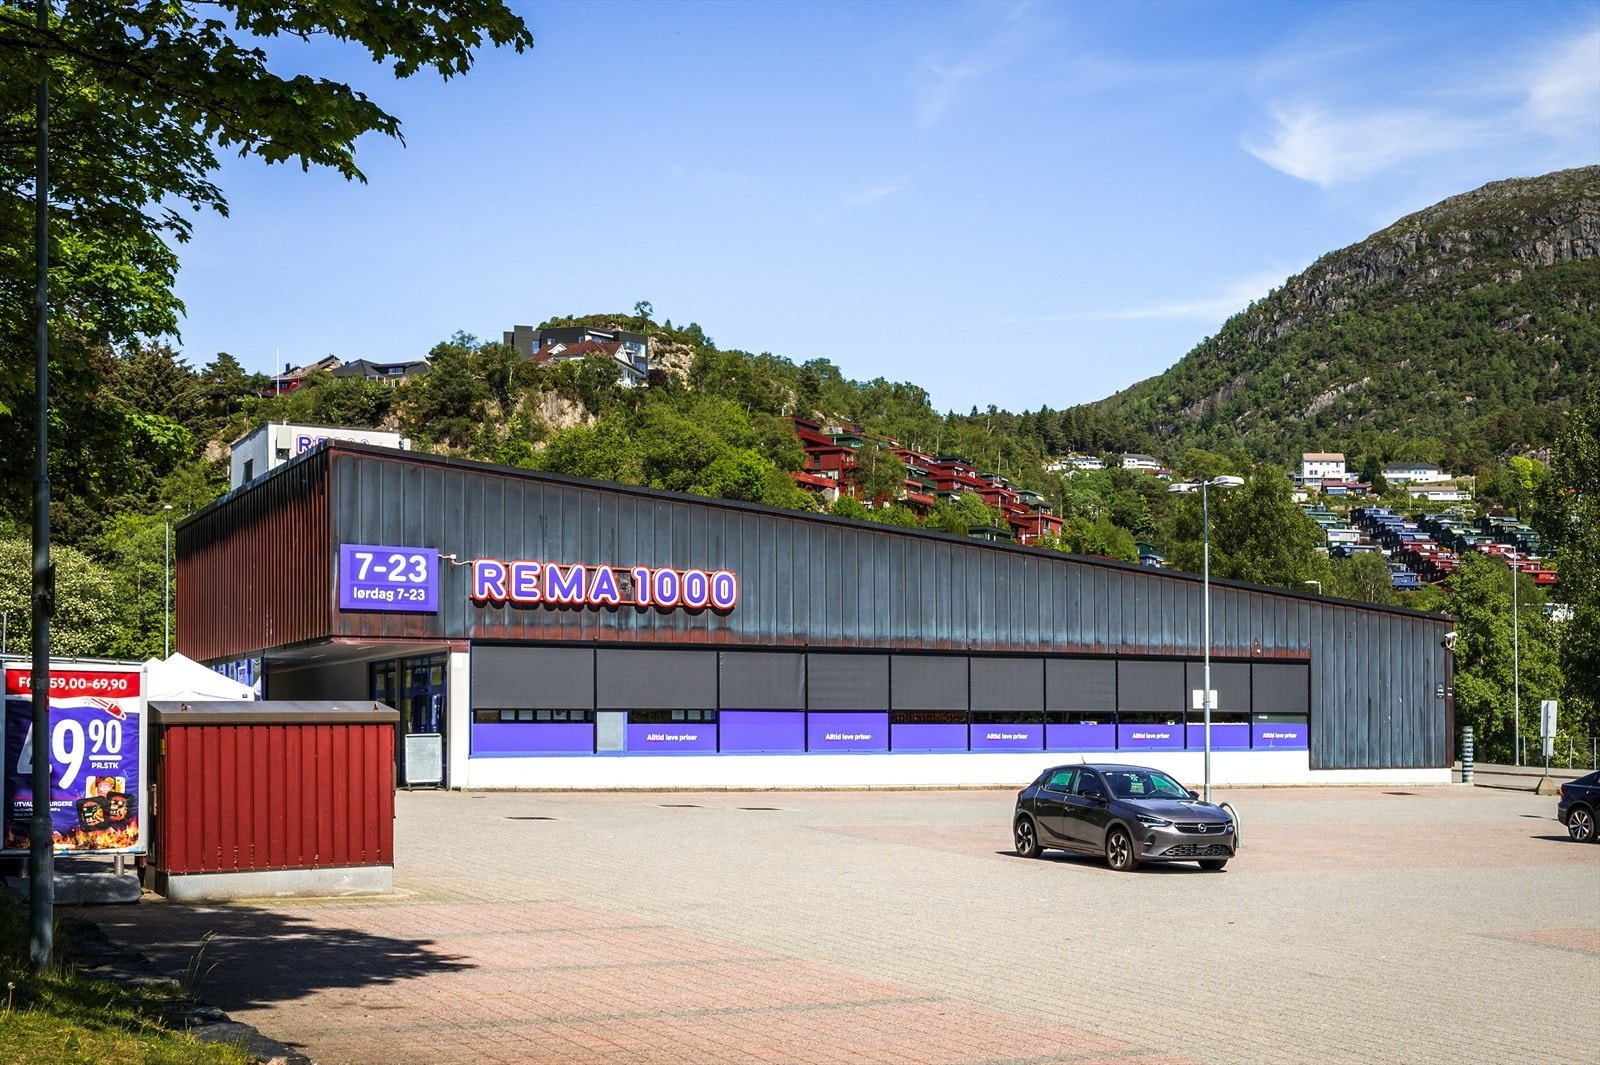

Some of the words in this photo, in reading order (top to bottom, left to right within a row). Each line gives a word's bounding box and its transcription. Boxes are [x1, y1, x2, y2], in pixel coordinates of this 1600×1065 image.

[355, 552, 427, 583] 7-23
[353, 586, 394, 602] lørdag
[397, 588, 425, 601] 7-23
[473, 559, 620, 605] REMA
[631, 565, 738, 609] 1000
[88, 719, 122, 753] 90
[680, 734, 697, 742] priser
